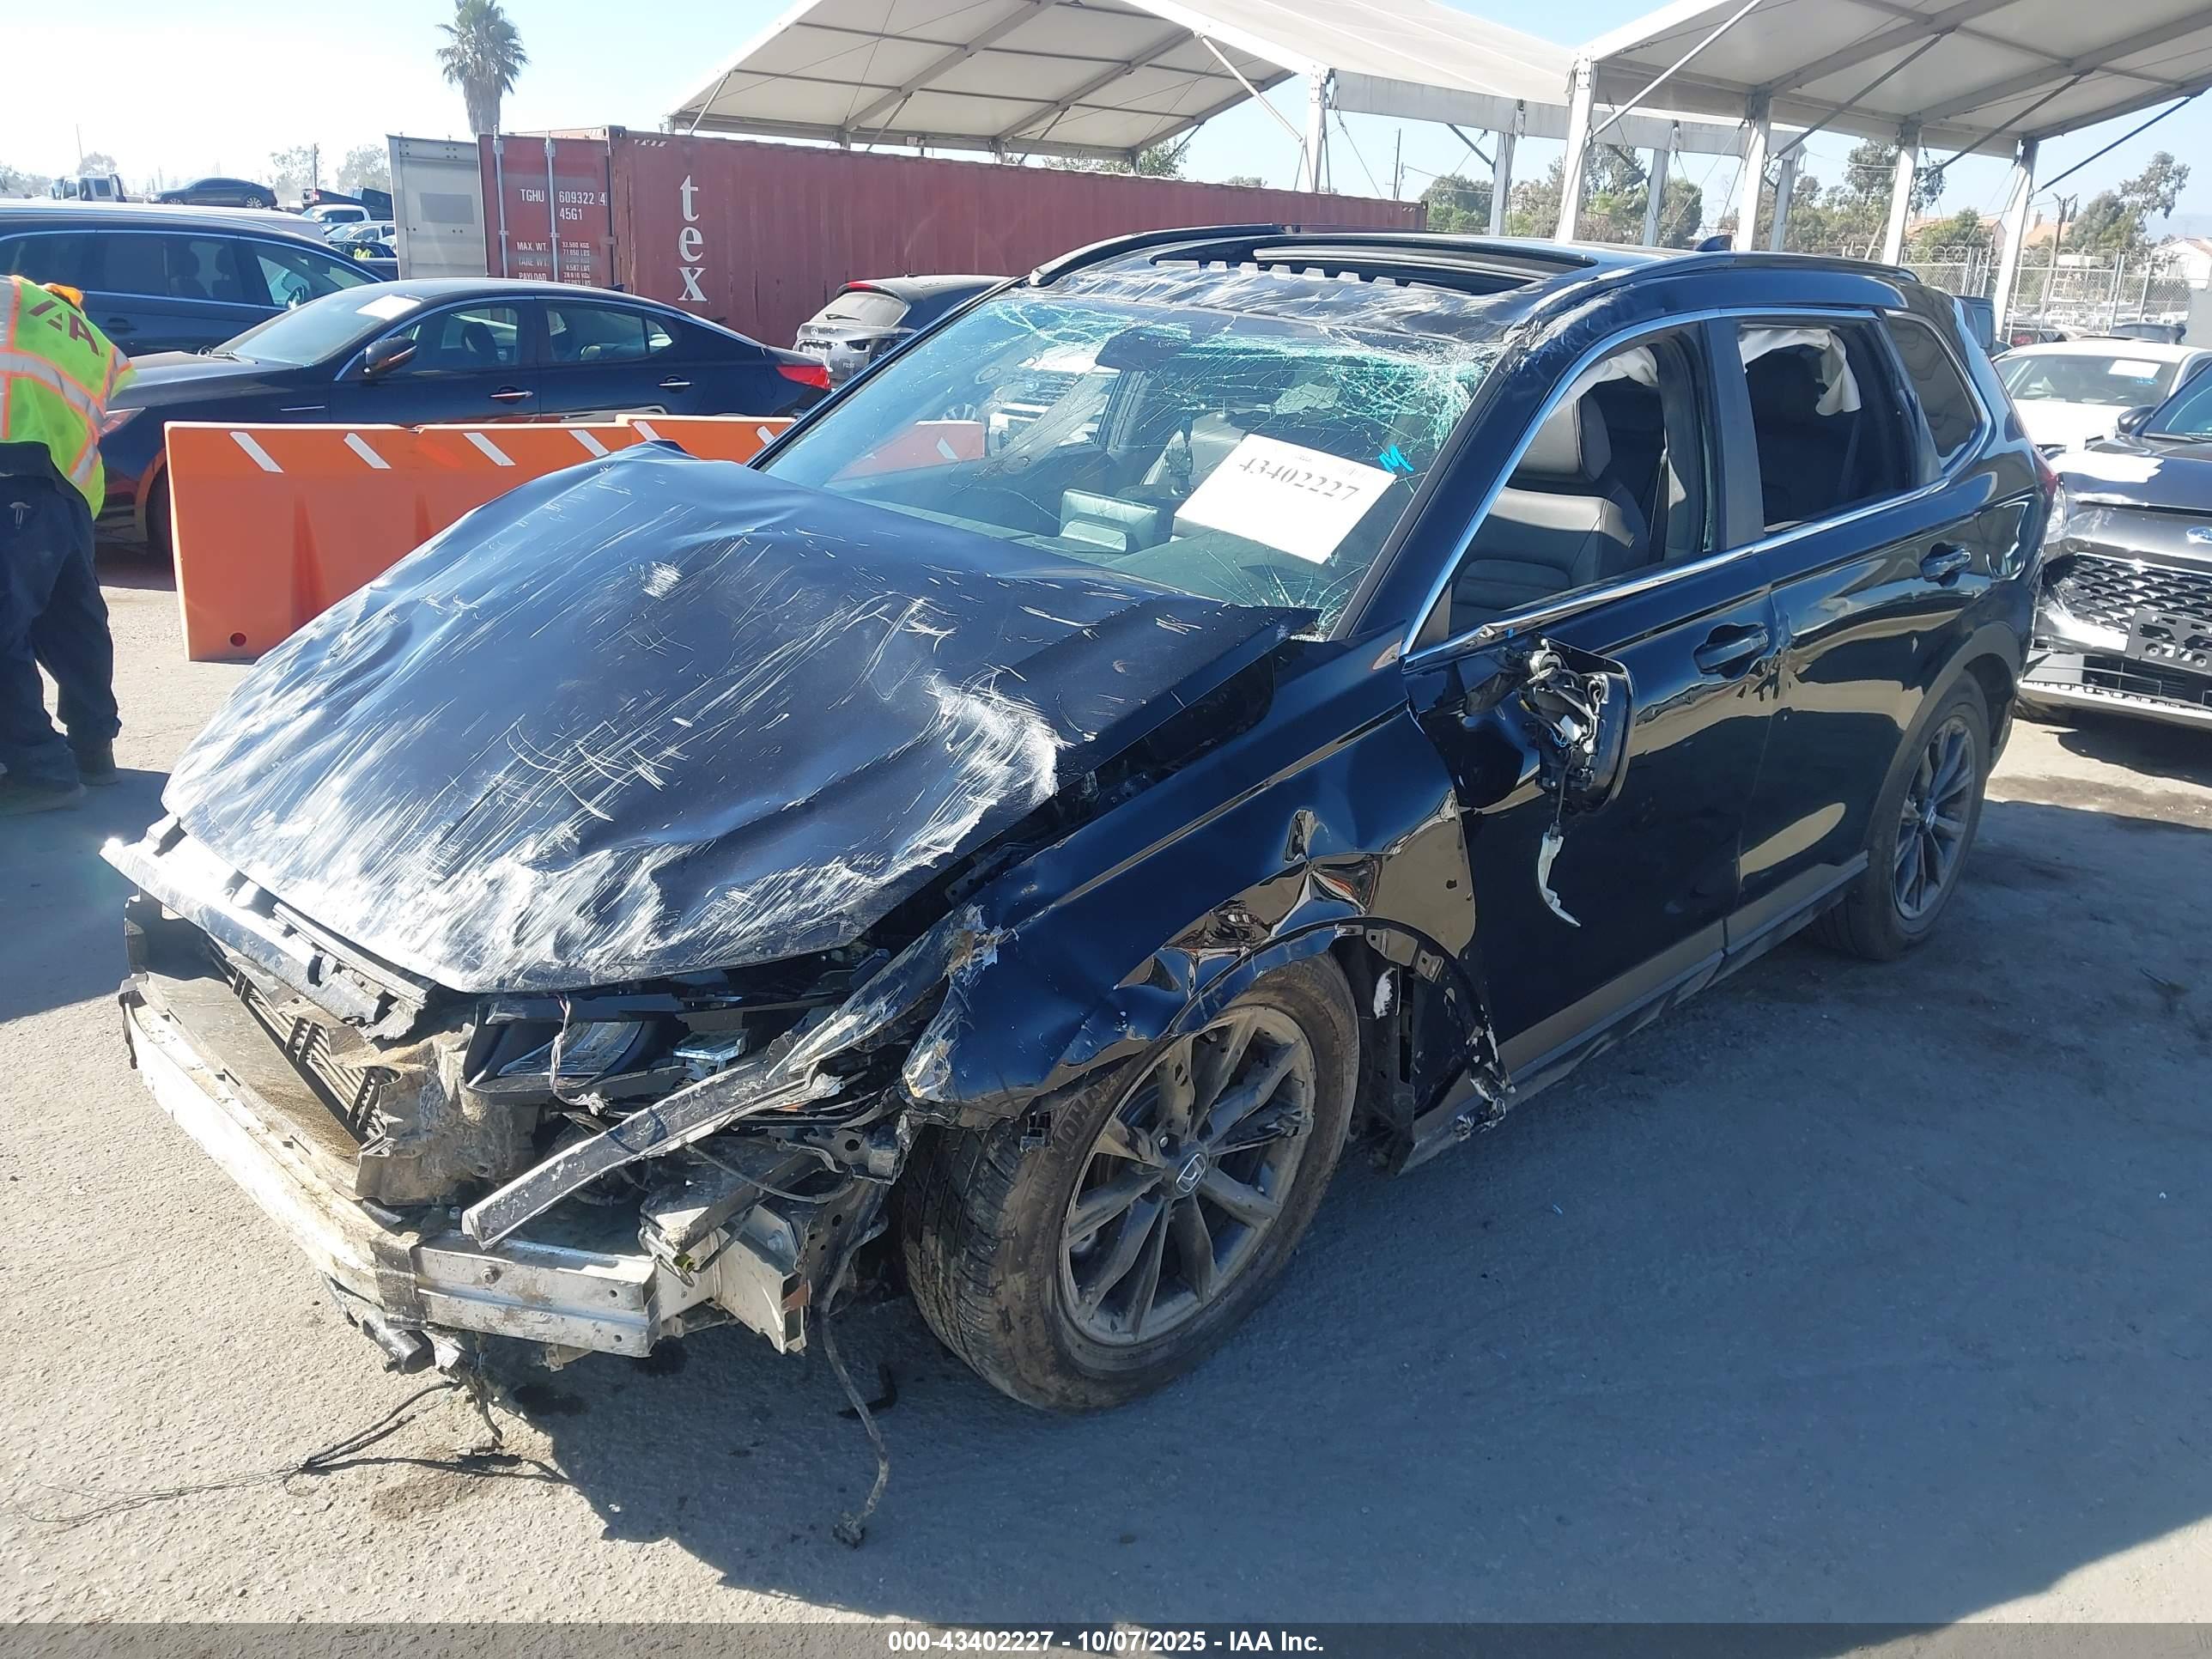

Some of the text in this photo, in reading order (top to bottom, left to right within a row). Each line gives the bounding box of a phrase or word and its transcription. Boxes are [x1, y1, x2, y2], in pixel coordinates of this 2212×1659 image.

[520, 188, 608, 206] TGHU 609322 4
[559, 207, 583, 221] 45G1
[678, 174, 708, 302] tex
[1238, 458, 1360, 501] 43402227
